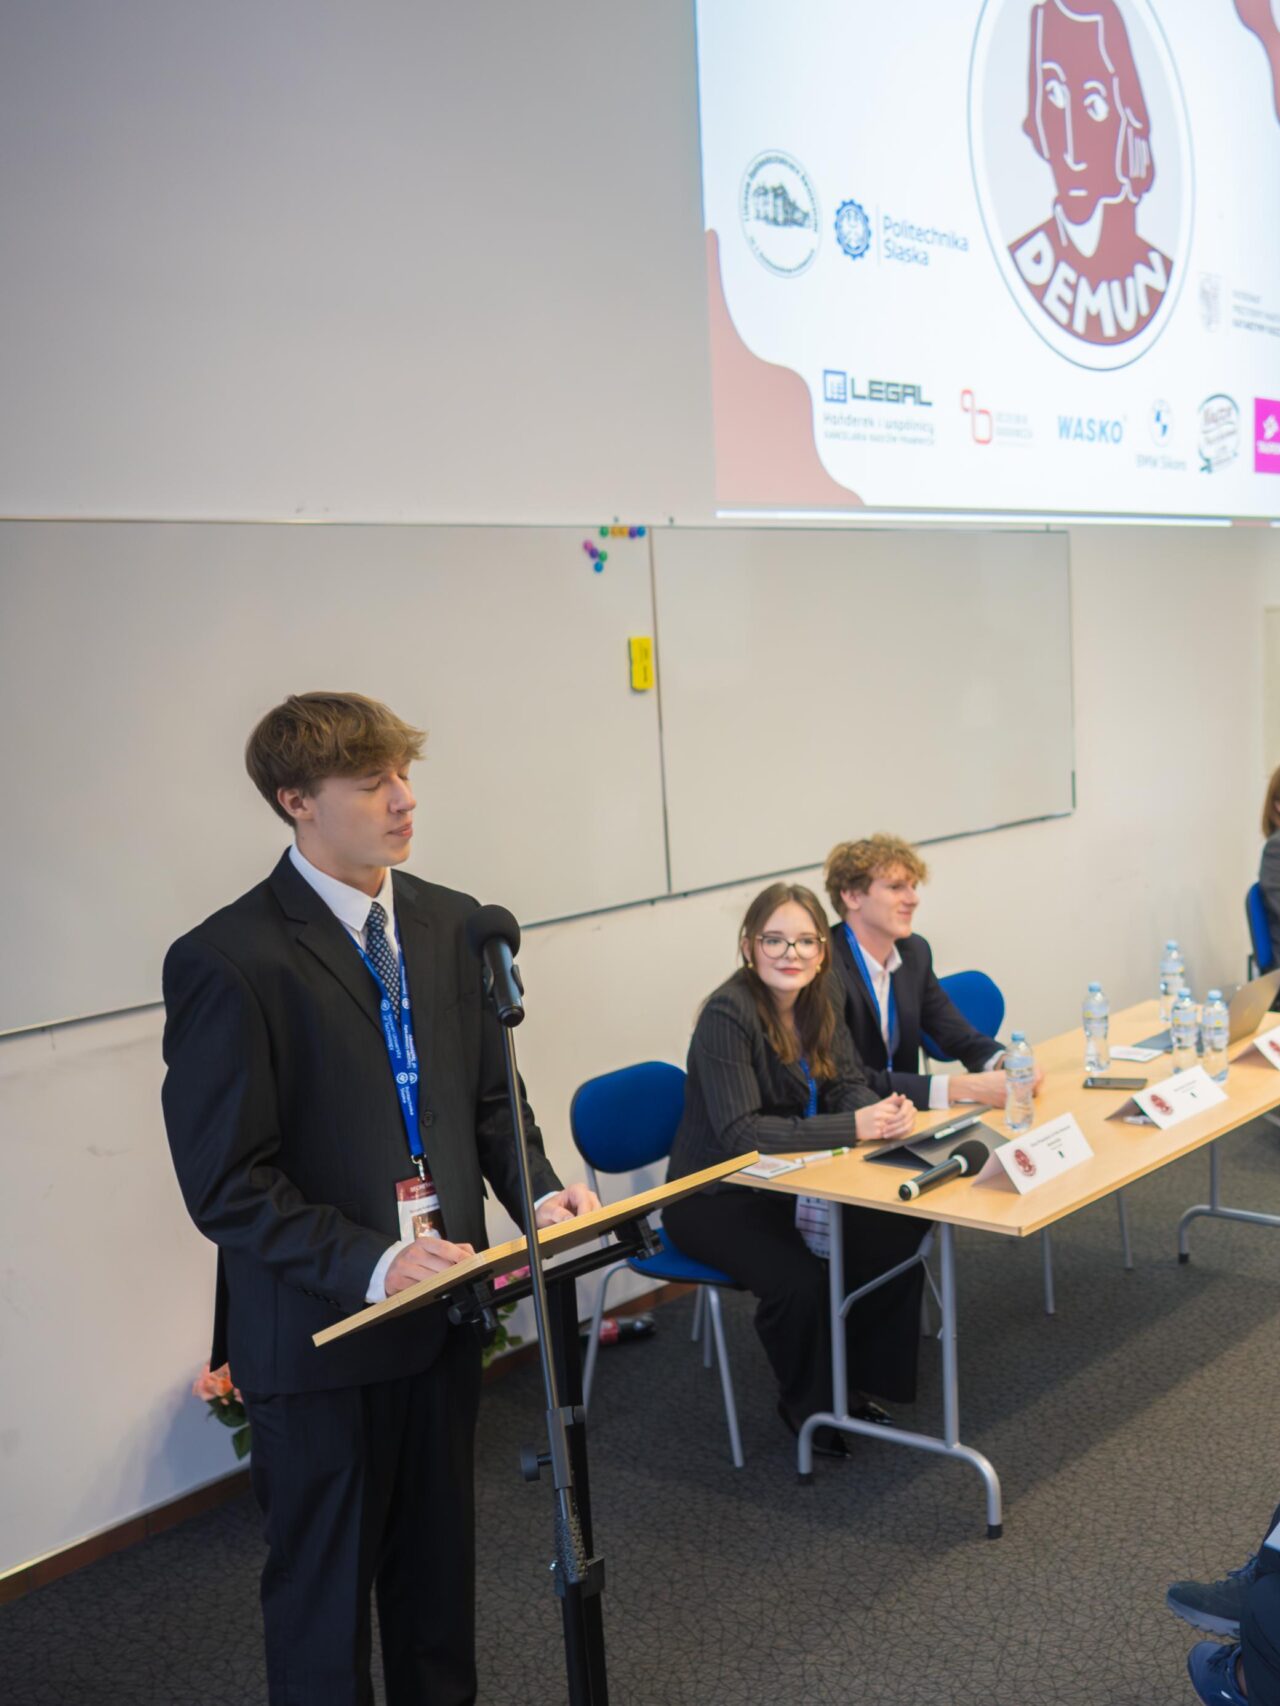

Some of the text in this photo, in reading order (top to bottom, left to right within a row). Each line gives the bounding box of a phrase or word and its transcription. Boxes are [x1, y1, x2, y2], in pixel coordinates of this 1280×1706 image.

[883, 215, 968, 252] Politechnika
[1013, 230, 1168, 338] DEMUN
[850, 377, 932, 407] LEGAL
[1057, 414, 1123, 445] WASKO
